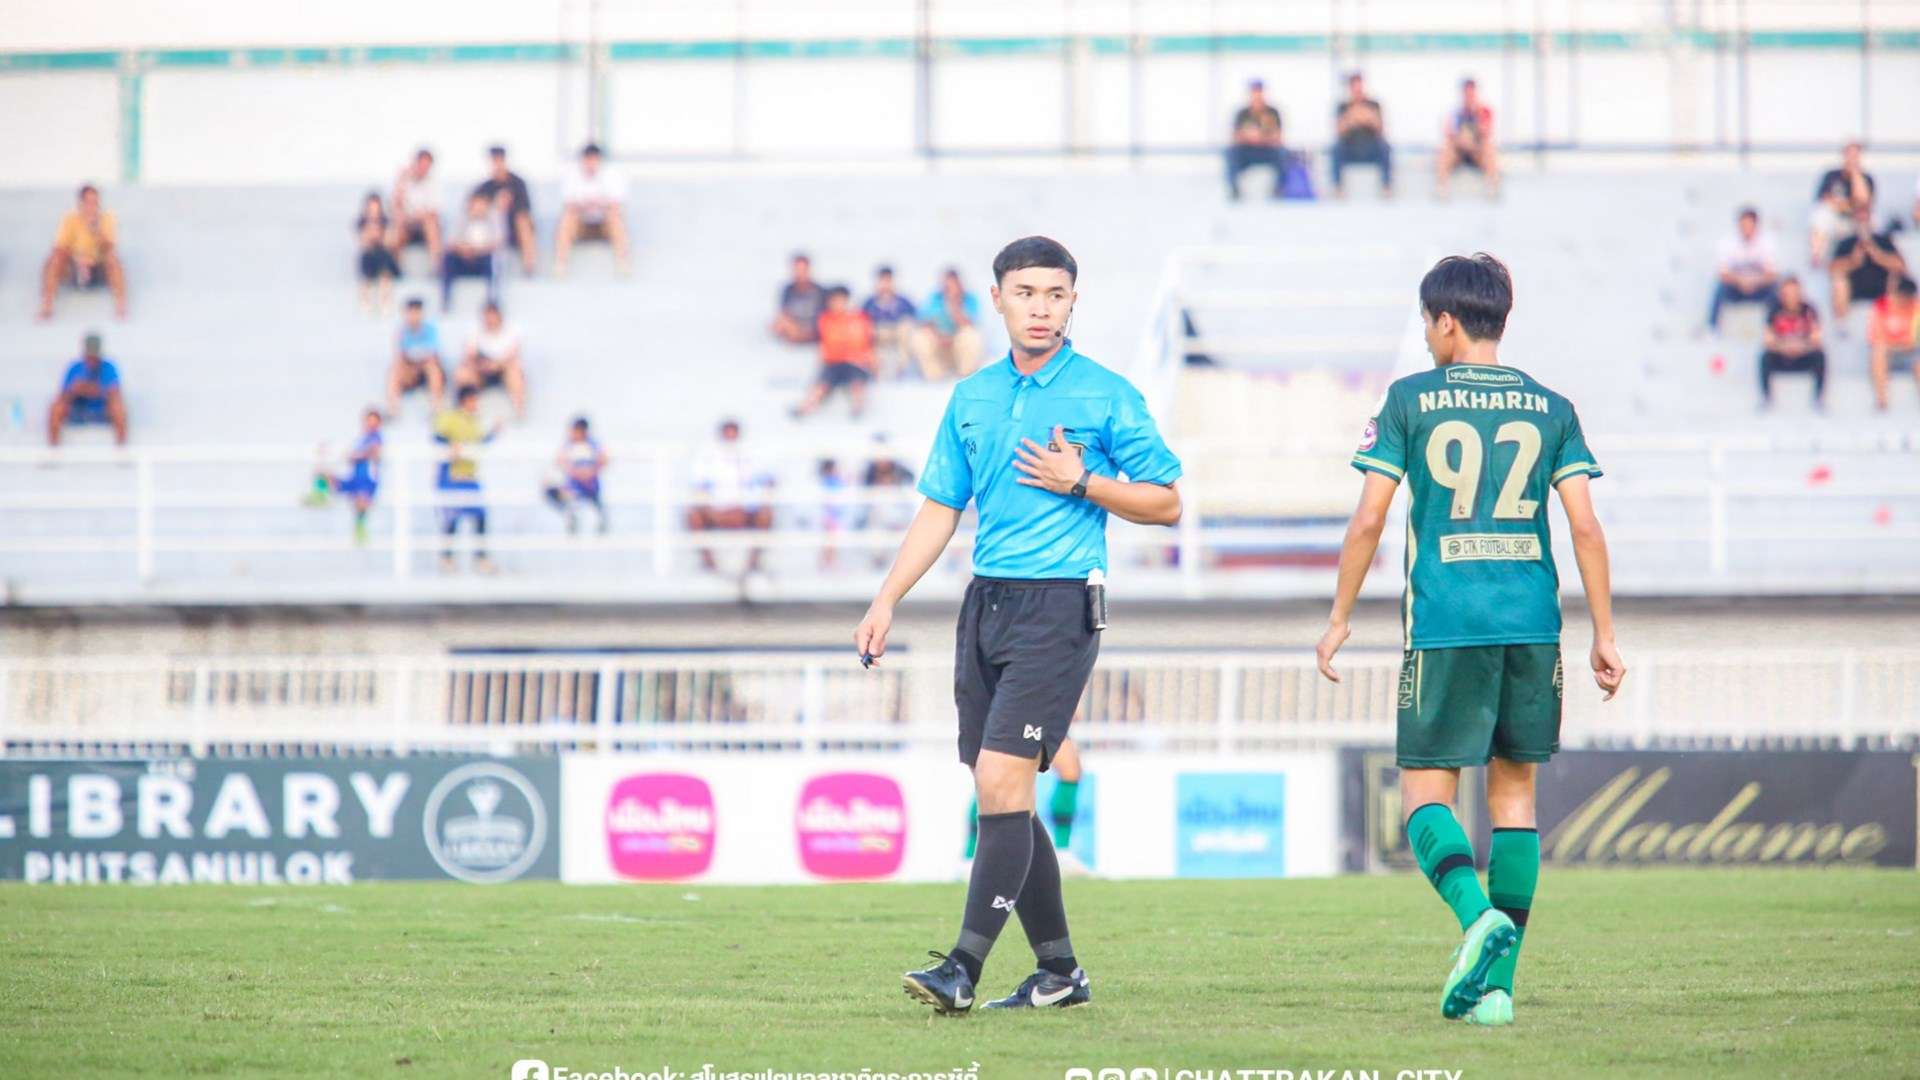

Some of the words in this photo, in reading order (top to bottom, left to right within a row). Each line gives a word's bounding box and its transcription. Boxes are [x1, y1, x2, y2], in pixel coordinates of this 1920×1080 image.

[1419, 388, 1549, 414] NAKHARIN
[1425, 420, 1541, 520] 92
[1463, 539, 1478, 554] CTK
[1480, 539, 1511, 554] FOOTBALL
[1513, 540, 1532, 554] SHOP
[1546, 766, 1886, 863] Madame
[24, 851, 354, 885] PHITSANULOK
